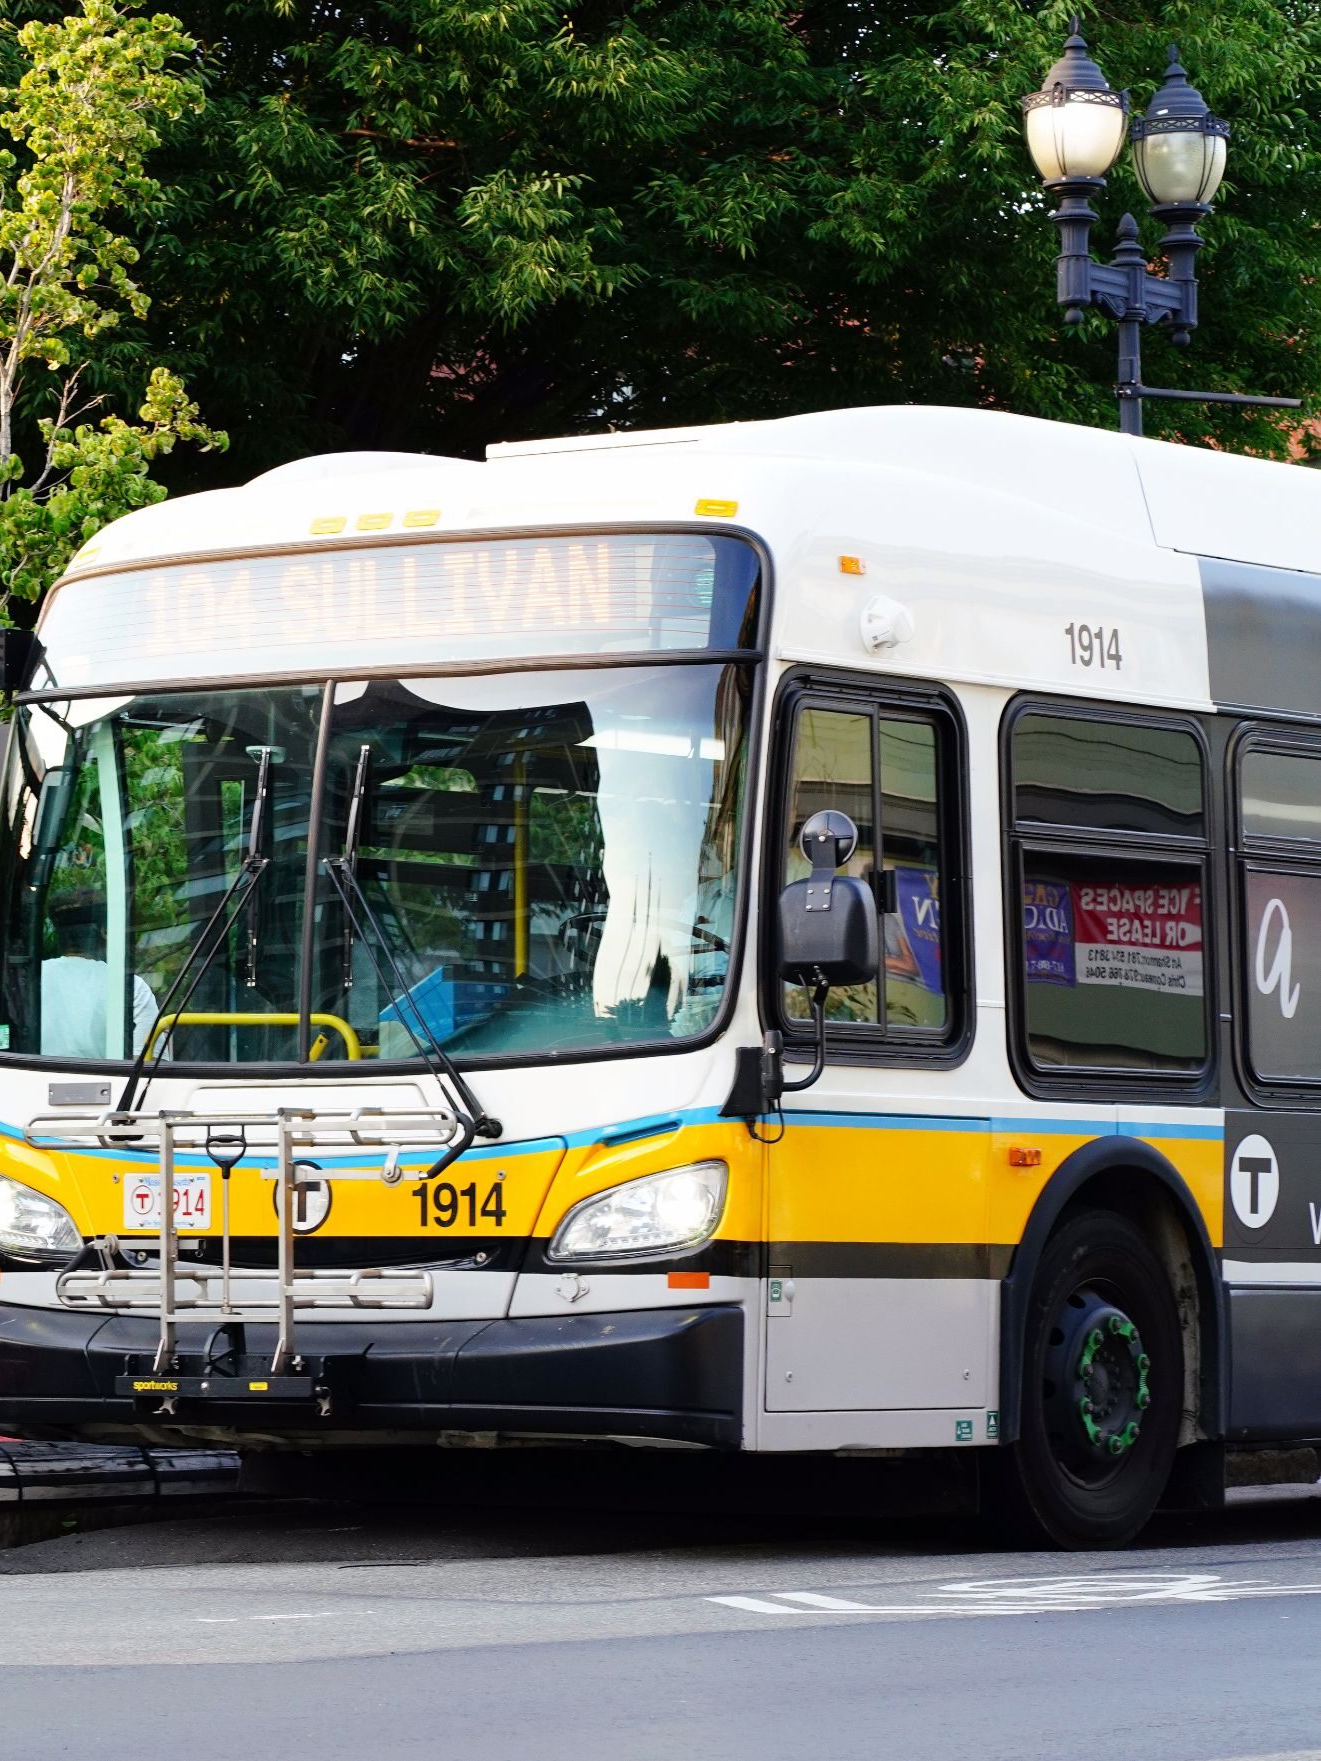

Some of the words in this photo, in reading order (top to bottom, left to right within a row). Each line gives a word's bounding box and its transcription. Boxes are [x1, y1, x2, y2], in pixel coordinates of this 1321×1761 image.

[280, 543, 611, 643] SULLIVAN
[1064, 622, 1122, 671] 1914
[135, 1193, 150, 1210] T
[292, 1181, 321, 1223] T
[411, 1182, 507, 1228] 1914
[1239, 1157, 1271, 1215] T
[133, 1381, 178, 1392] sportworks
